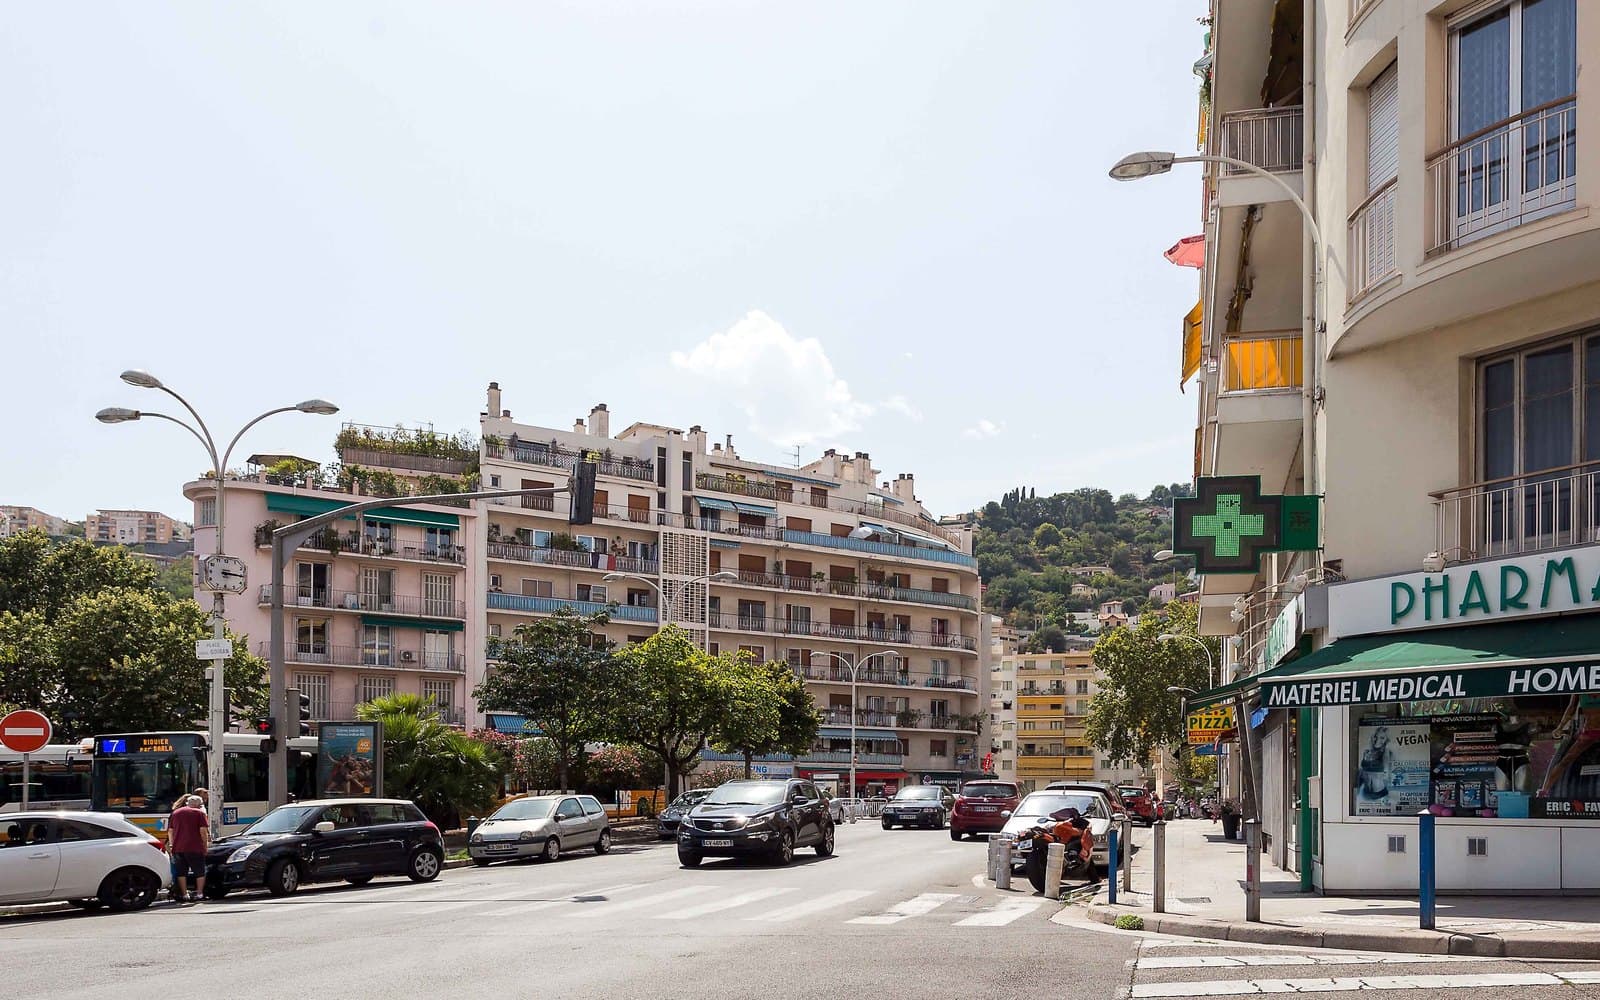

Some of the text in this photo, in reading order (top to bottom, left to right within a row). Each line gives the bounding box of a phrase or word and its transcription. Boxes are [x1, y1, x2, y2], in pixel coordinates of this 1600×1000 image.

[1269, 680, 1361, 706] MATERIEL
[1367, 674, 1466, 701] MEDICAL
[1189, 716, 1231, 729] PIZZA
[1431, 715, 1476, 724] INNOVATION
[108, 739, 119, 753] 7
[1396, 733, 1431, 747] VEGAN
[1546, 801, 1571, 812] ERIC
